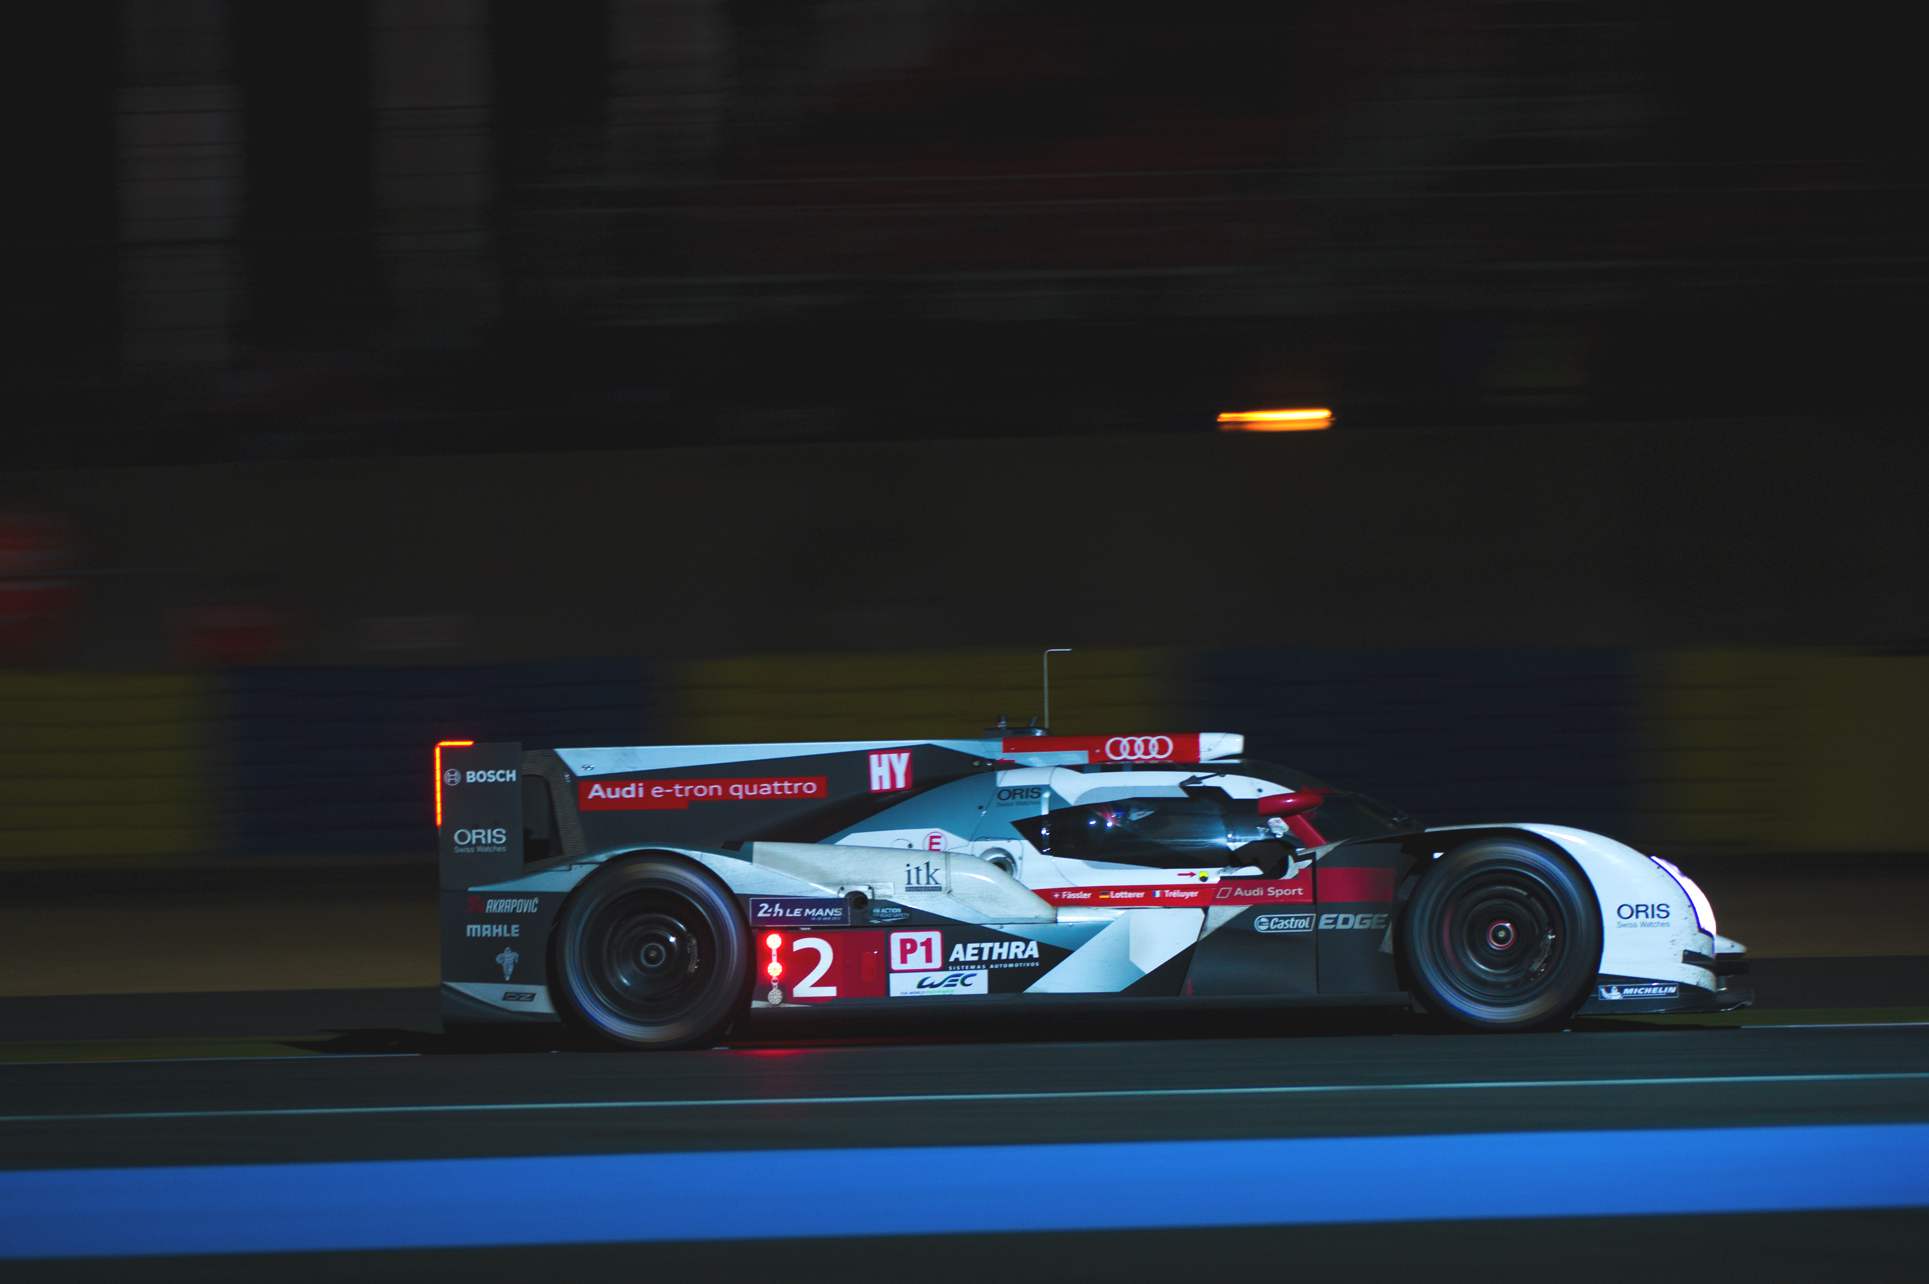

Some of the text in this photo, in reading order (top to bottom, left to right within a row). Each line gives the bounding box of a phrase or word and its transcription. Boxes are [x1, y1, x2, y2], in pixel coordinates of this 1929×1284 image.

[465, 769, 517, 783] BOSCH
[868, 752, 911, 791] HY
[588, 780, 817, 800] Audi e-tron quattro
[997, 787, 1041, 801] ORIS
[453, 828, 507, 846] ORIS
[928, 835, 942, 851] E
[905, 862, 941, 886] itk
[1110, 890, 1145, 899] Lotterer
[1233, 886, 1304, 898] Audi Sport
[785, 908, 802, 917] LE
[803, 907, 844, 917] MANS
[1616, 903, 1671, 920] ORIS
[1269, 913, 1389, 930] Castrol EDGE
[1616, 921, 1638, 929] Swiss
[466, 924, 520, 938] MAHLE
[899, 937, 933, 965] P1
[949, 941, 1040, 962] AETHRA
[792, 937, 838, 998] 2
[916, 973, 978, 989] WEC
[1623, 986, 1678, 995] MICHELIN
